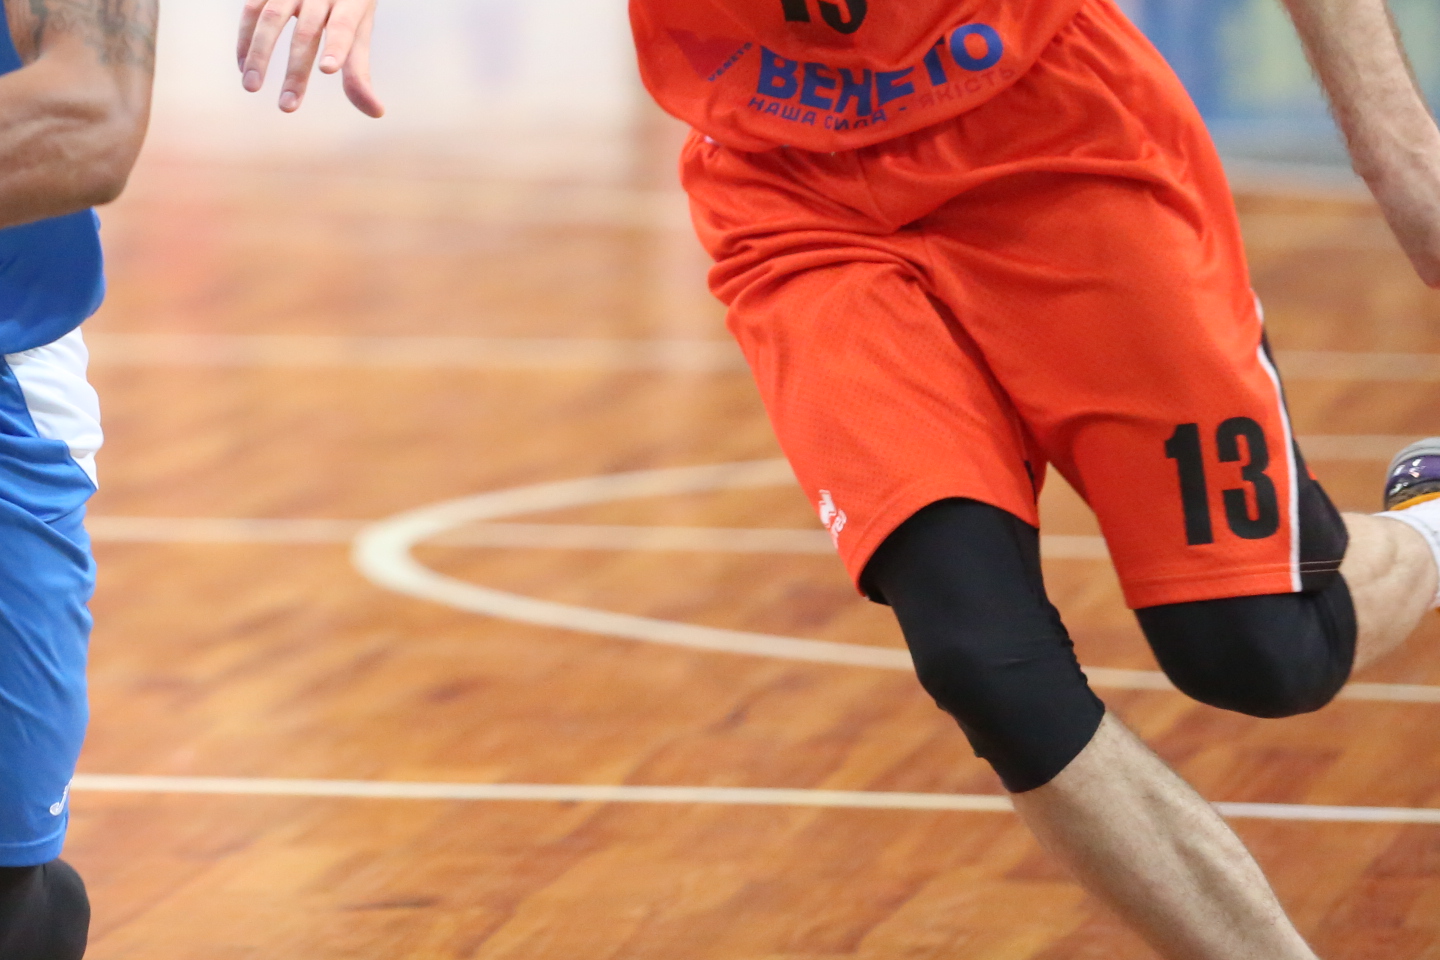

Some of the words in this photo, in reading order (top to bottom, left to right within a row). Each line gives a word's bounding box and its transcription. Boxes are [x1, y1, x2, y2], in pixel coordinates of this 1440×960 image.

[747, 97, 817, 126] НАША
[824, 109, 888, 131] СИЛА
[1165, 416, 1280, 547] 13
